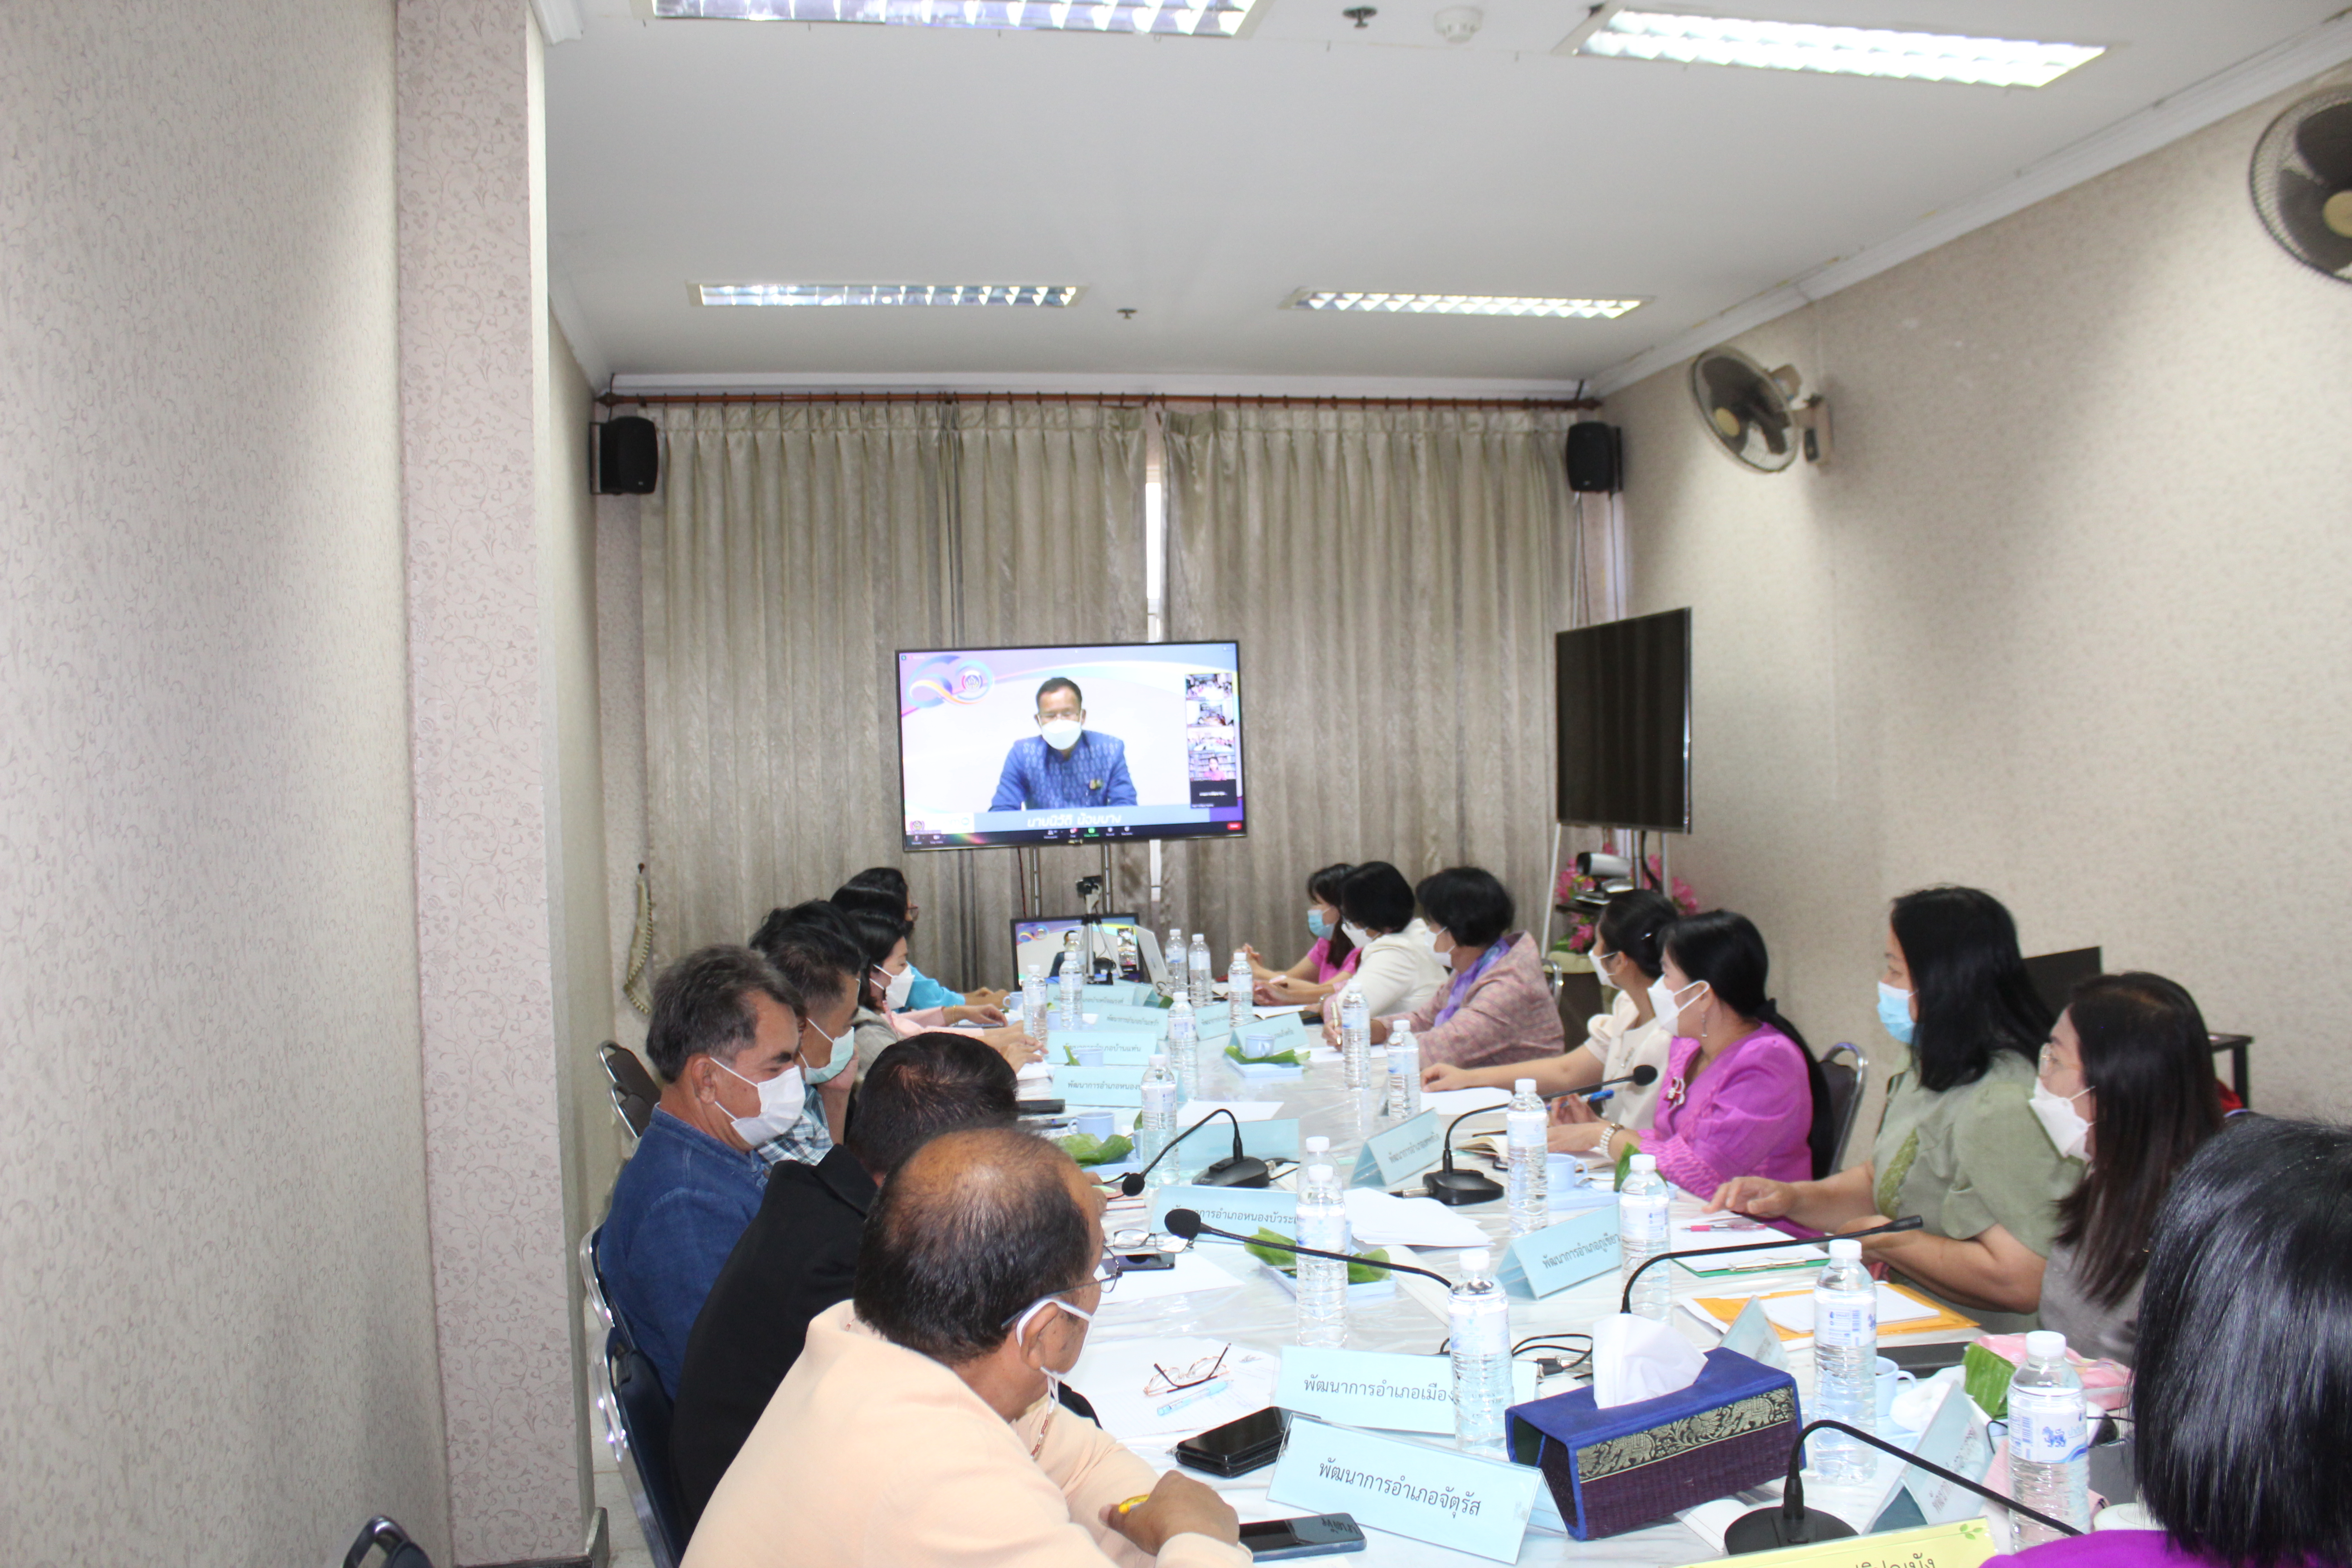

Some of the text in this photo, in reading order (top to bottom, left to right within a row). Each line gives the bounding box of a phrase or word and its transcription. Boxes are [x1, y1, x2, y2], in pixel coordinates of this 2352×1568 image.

[1319, 1457, 1481, 1519] พัฒนาการอำเภอจัตุรัส
